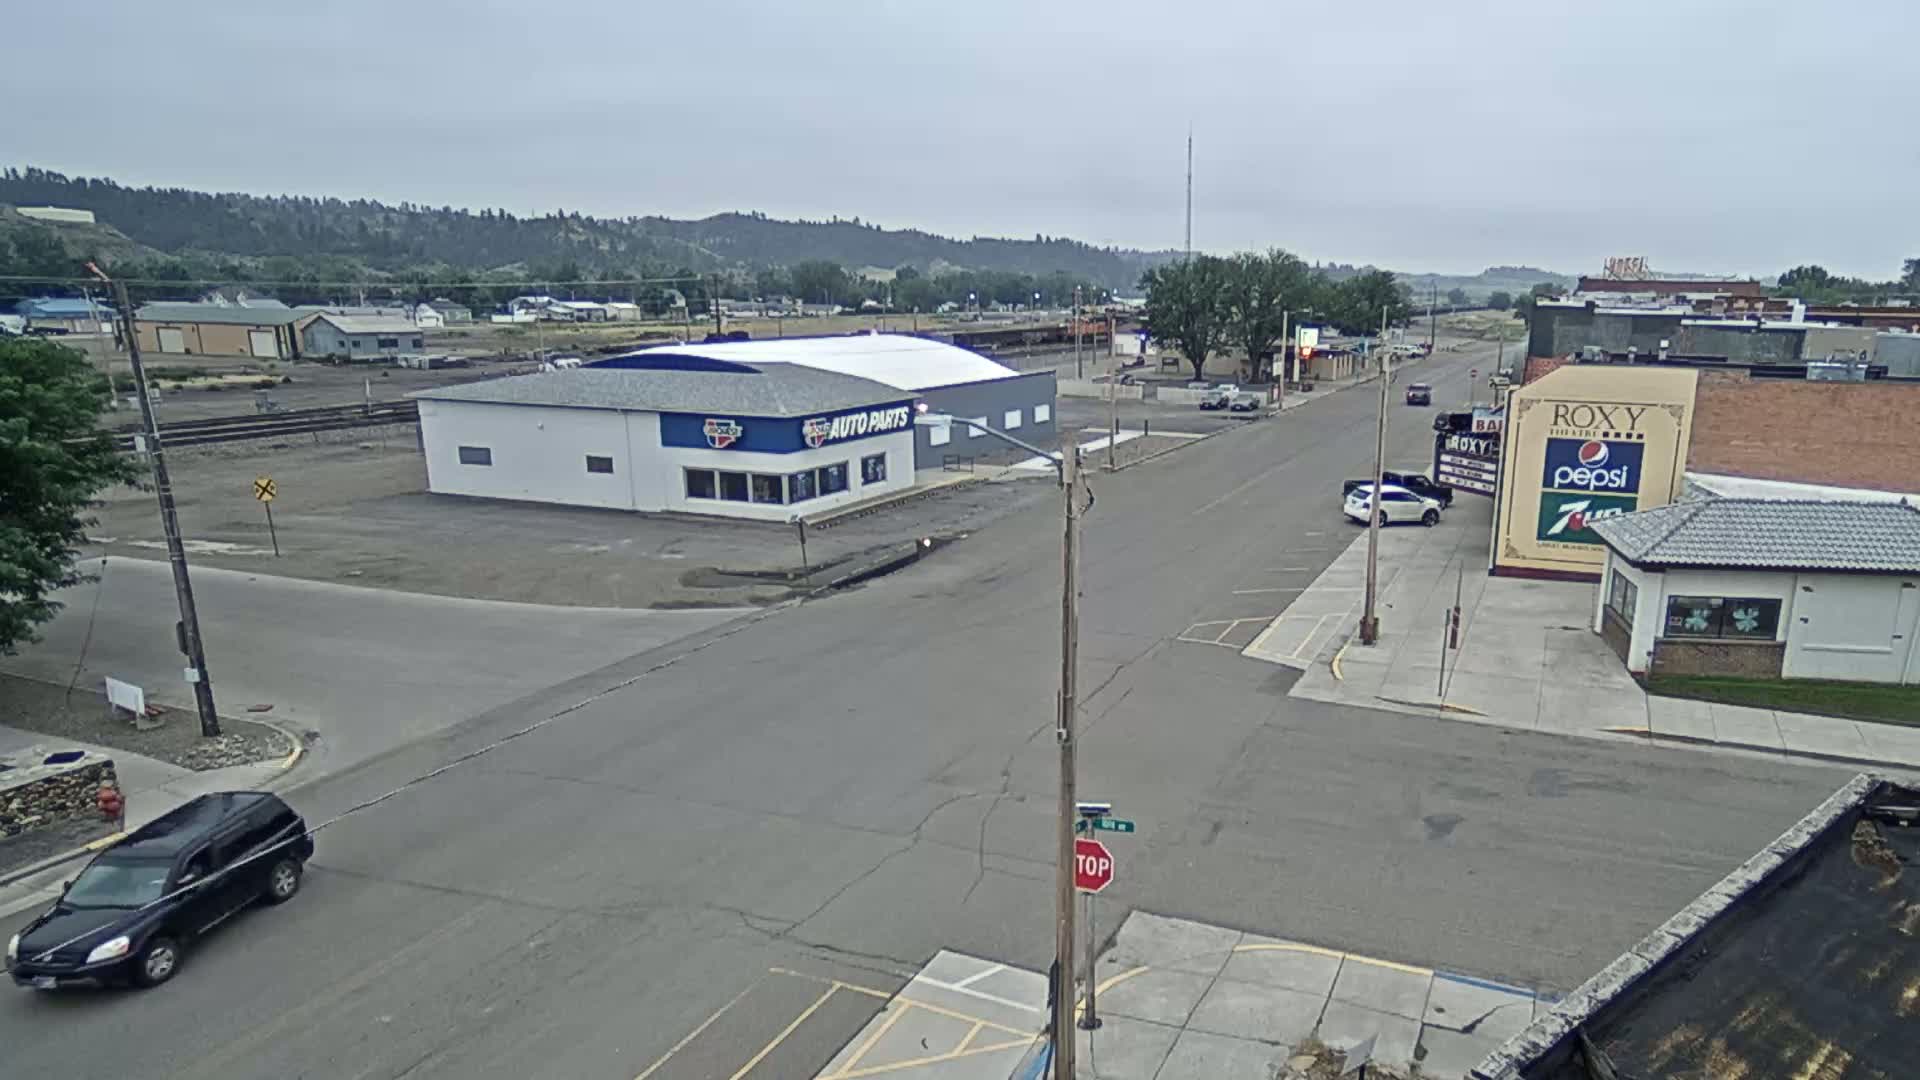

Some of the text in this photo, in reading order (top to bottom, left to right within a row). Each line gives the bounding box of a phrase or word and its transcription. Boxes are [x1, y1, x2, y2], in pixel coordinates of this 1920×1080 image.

[828, 412, 867, 440] AUTO
[867, 406, 909, 432] PARTS
[1550, 404, 1646, 430] ROXY
[1445, 435, 1488, 455] ROXY
[1553, 465, 1628, 491] pepsi
[1076, 855, 1110, 877] TOP
